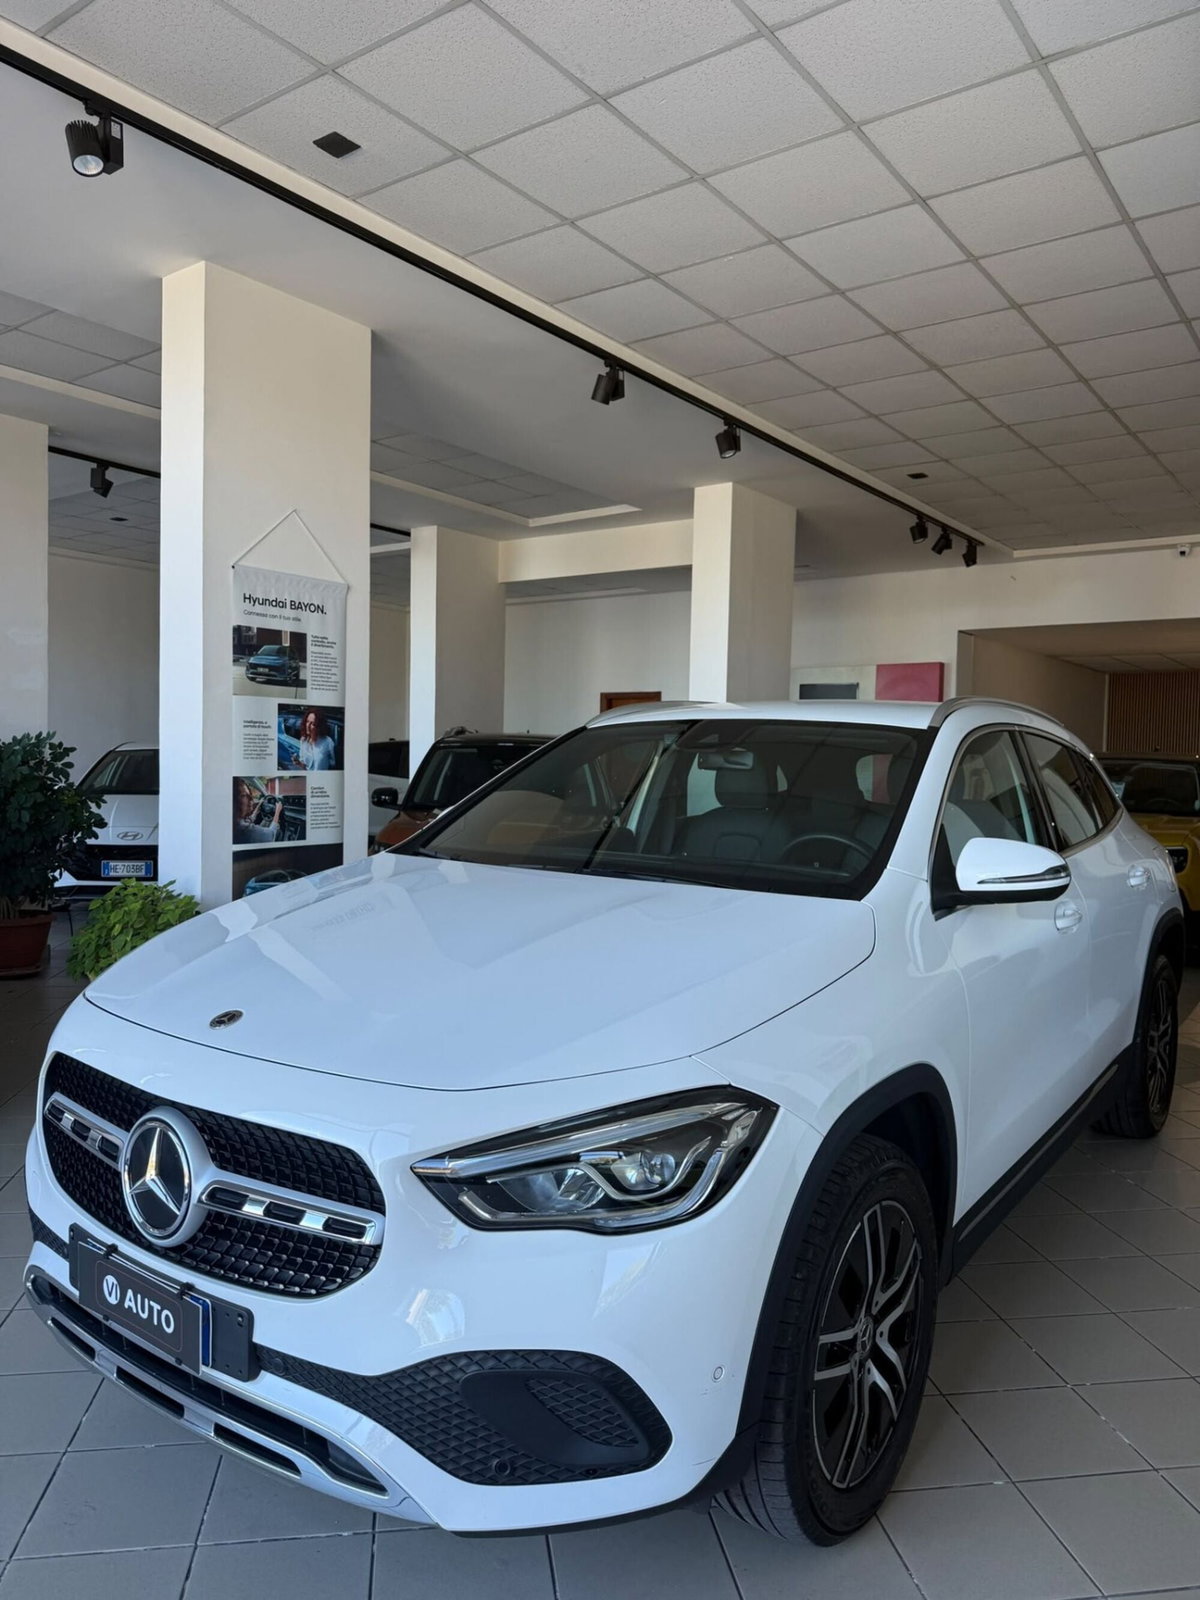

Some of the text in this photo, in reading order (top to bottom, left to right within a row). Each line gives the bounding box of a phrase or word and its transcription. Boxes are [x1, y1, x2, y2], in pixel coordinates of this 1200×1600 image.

[243, 593, 327, 615] Hyundai BAYON.
[124, 1288, 175, 1334] AUTO
